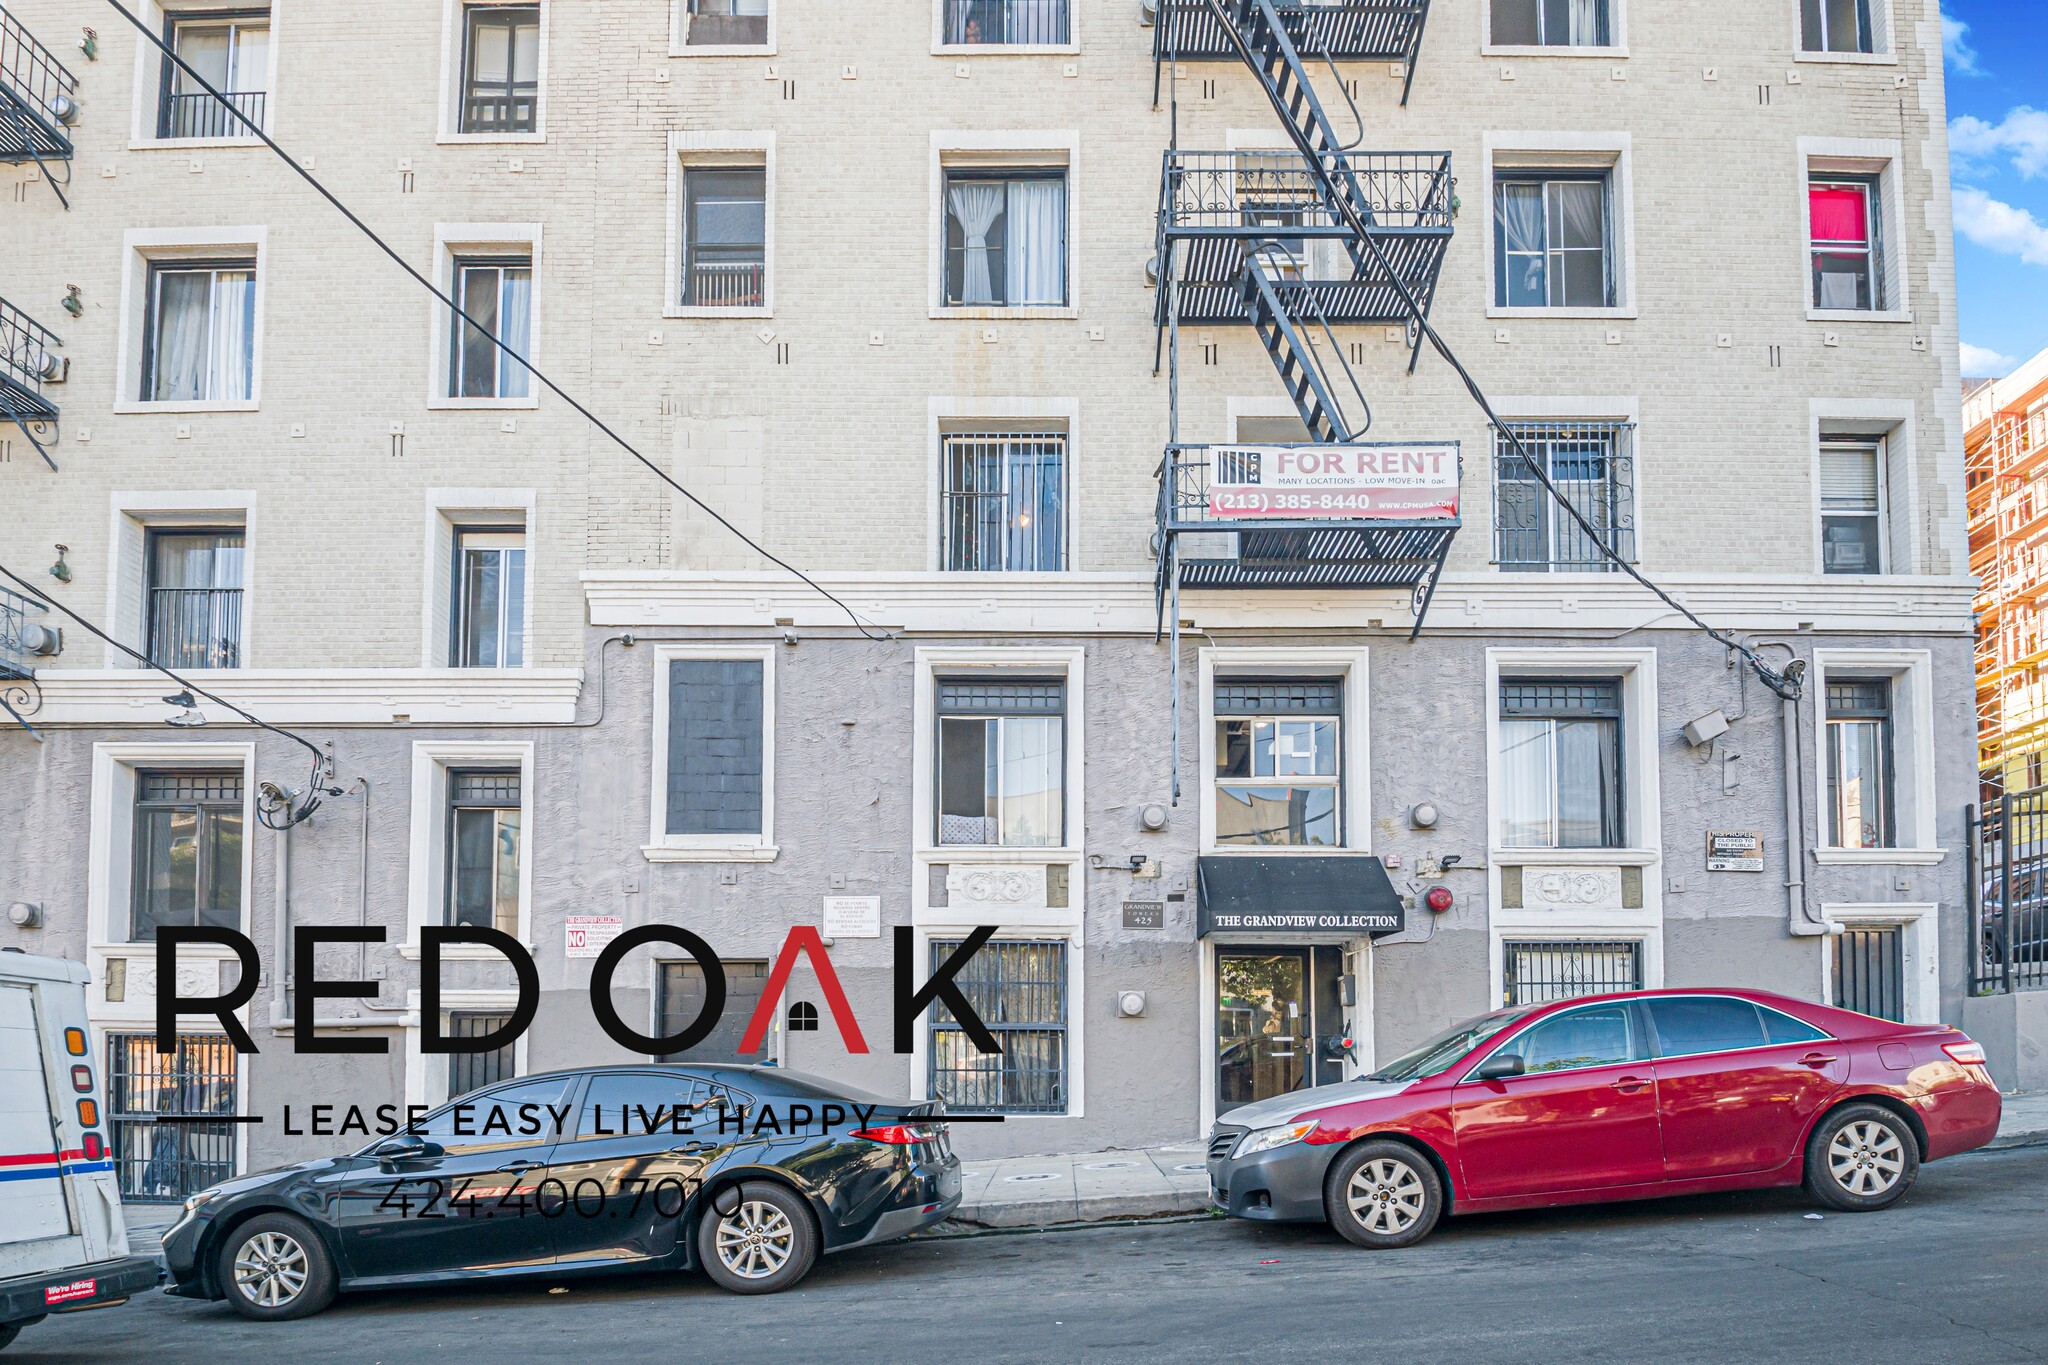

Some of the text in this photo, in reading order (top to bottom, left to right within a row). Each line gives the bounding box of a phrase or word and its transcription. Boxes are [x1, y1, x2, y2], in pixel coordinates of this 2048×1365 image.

[1249, 453, 1258, 482] CPM
[1277, 451, 1447, 474] FOR RENT
[1388, 477, 1426, 485] MOVE-IN
[1214, 493, 1370, 512] (213) 385-8440
[1378, 500, 1453, 510] WWW.CPMUSA.COM
[1134, 916, 1152, 926] 425
[1215, 915, 1398, 927] THE GRANDVIEW COLLECTION
[568, 931, 585, 947] NO
[48, 1281, 93, 1295] We're Hiring
